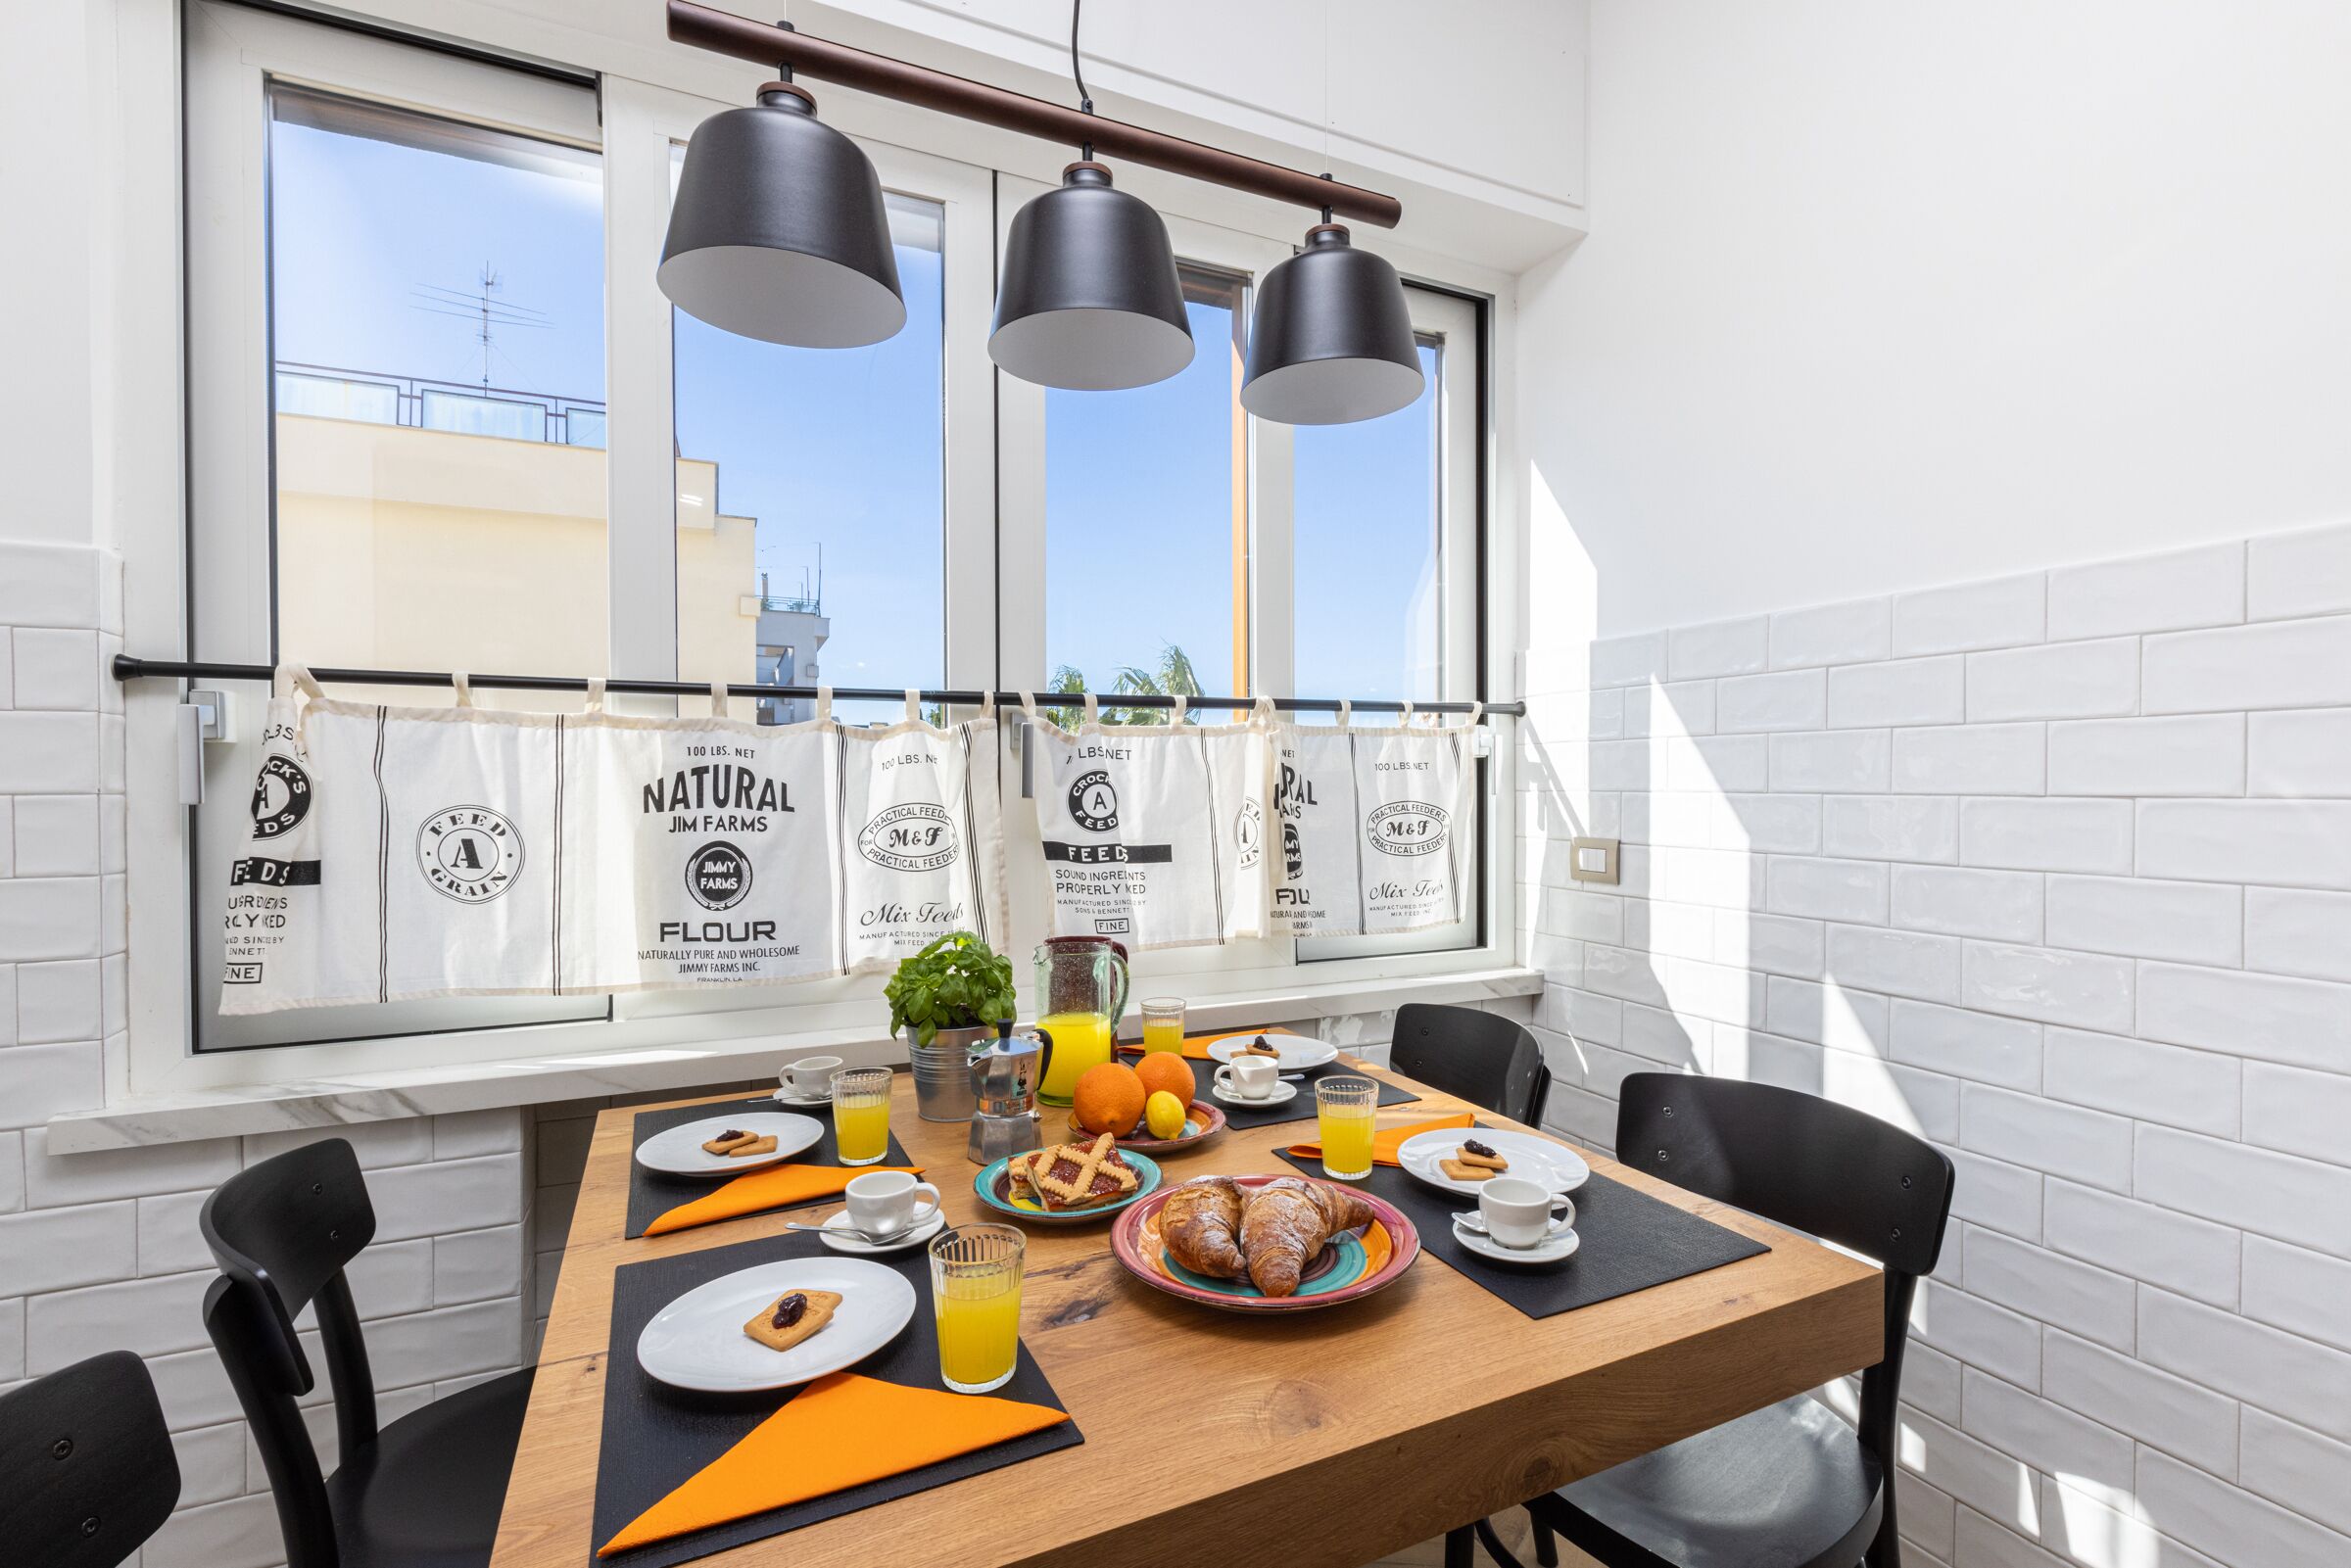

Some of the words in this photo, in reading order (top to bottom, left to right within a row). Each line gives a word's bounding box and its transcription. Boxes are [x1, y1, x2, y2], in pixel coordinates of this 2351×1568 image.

[687, 746, 706, 757] 100
[711, 745, 731, 757] LBS.
[736, 747, 755, 759] NET
[898, 754, 922, 765] LBS.
[1105, 748, 1131, 760] NET
[643, 764, 795, 814] NATURAL
[1093, 791, 1108, 811] A
[868, 807, 917, 834] PRACTICAL
[1076, 810, 1117, 830] FEED
[1371, 804, 1410, 825] PRACTICAL
[1412, 804, 1447, 823] FEEDERS
[429, 813, 506, 837] FEED
[668, 816, 697, 833] JIM
[703, 815, 768, 832] FARMS
[1386, 822, 1404, 837] M
[1406, 824, 1415, 835] &
[888, 829, 909, 848] M
[911, 831, 922, 845] &
[925, 827, 943, 846] F
[1371, 835, 1414, 854] PRACTICAL
[450, 838, 484, 870] A
[867, 848, 920, 869] PRACTICAL
[702, 861, 737, 874] JIMMY
[1055, 869, 1087, 881] SOUND
[431, 868, 507, 897] GRAIN
[700, 878, 739, 890] FARMS
[1056, 882, 1121, 895] PROPERLY
[1369, 881, 1407, 900] Mix
[1057, 898, 1112, 907] MANUFACTURED
[860, 901, 911, 927] Mix
[659, 921, 777, 943] FLOUR
[859, 930, 921, 940] MANUFACTURED
[1098, 922, 1126, 931] FINE
[637, 950, 692, 961] NATURALLY
[694, 949, 715, 960] PURE
[717, 949, 737, 960] AND
[740, 945, 800, 959] WHOLESOME
[678, 963, 708, 974] JIMMY
[710, 962, 740, 973] FARMS
[742, 961, 761, 973] INC.
